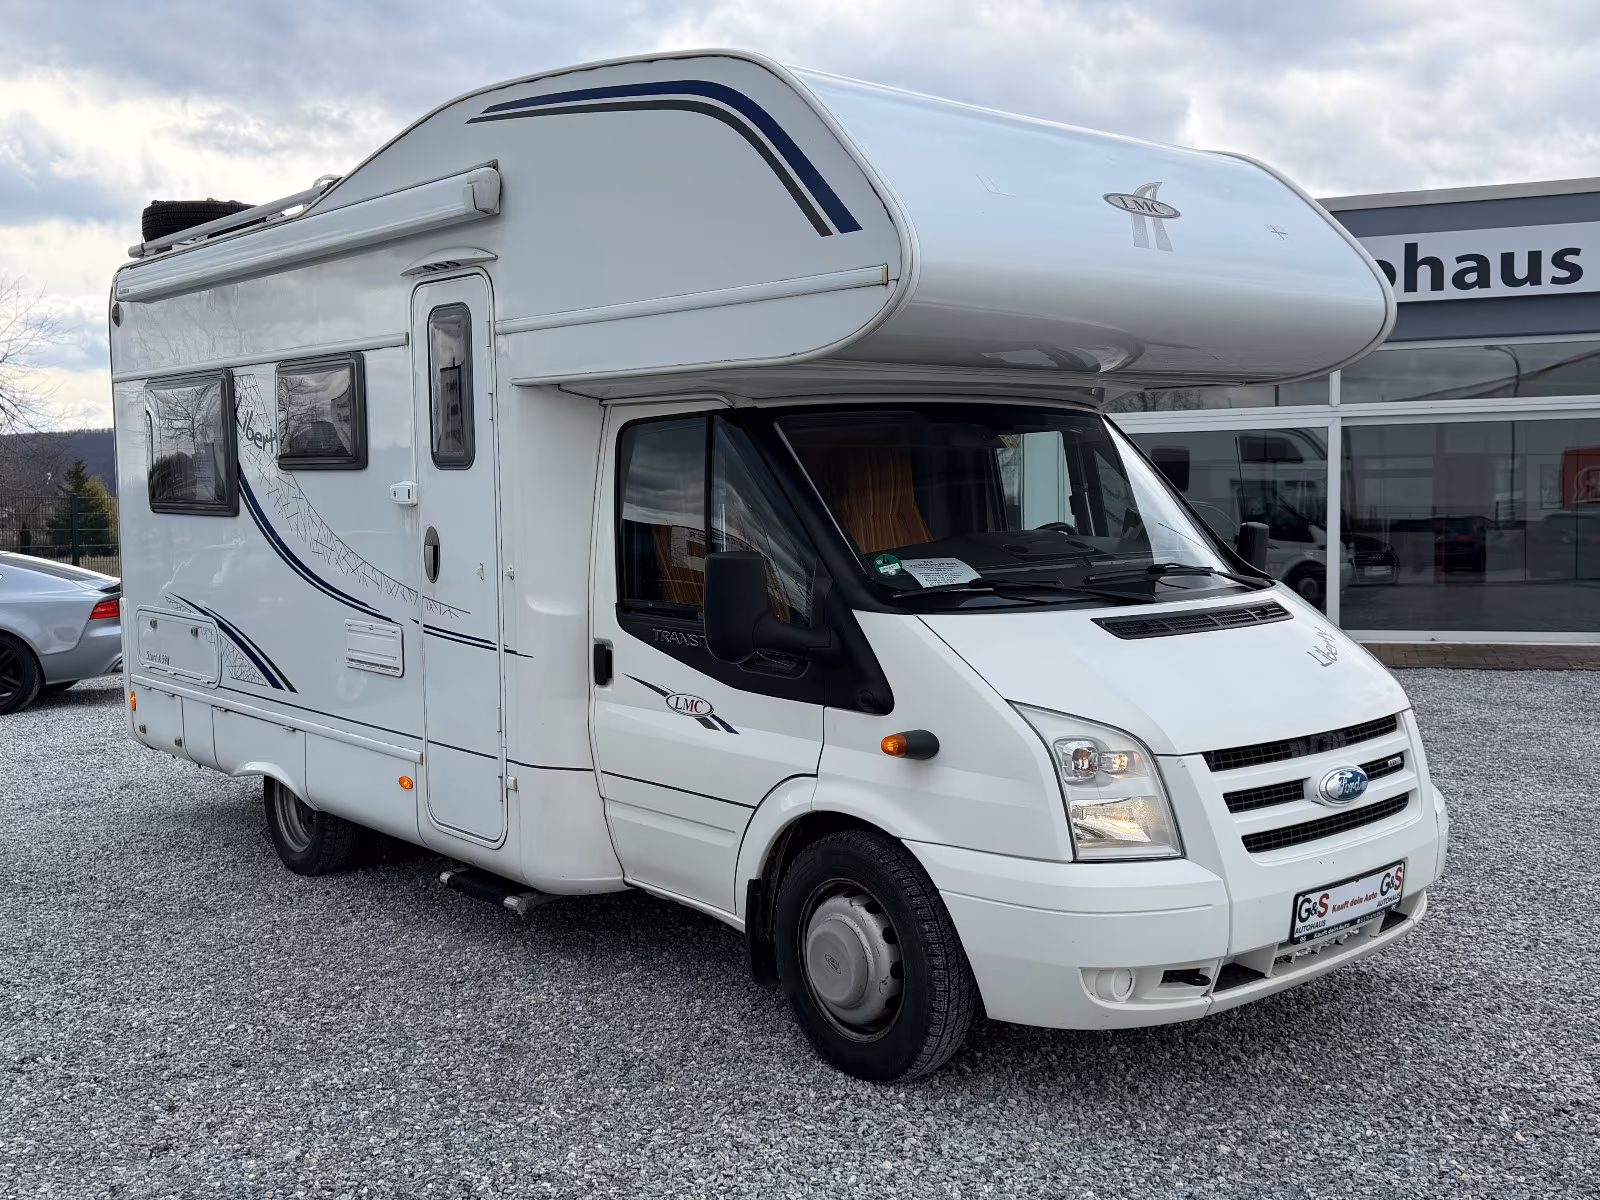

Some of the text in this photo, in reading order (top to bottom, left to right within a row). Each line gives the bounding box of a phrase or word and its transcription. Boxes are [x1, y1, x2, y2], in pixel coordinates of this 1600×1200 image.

[1117, 196, 1165, 215] LMC
[674, 696, 704, 714] LMC
[1337, 770, 1361, 794] Ford
[1380, 866, 1403, 896] G&S
[1297, 893, 1330, 923] G&S
[1295, 920, 1327, 934] AUTOHAUS
